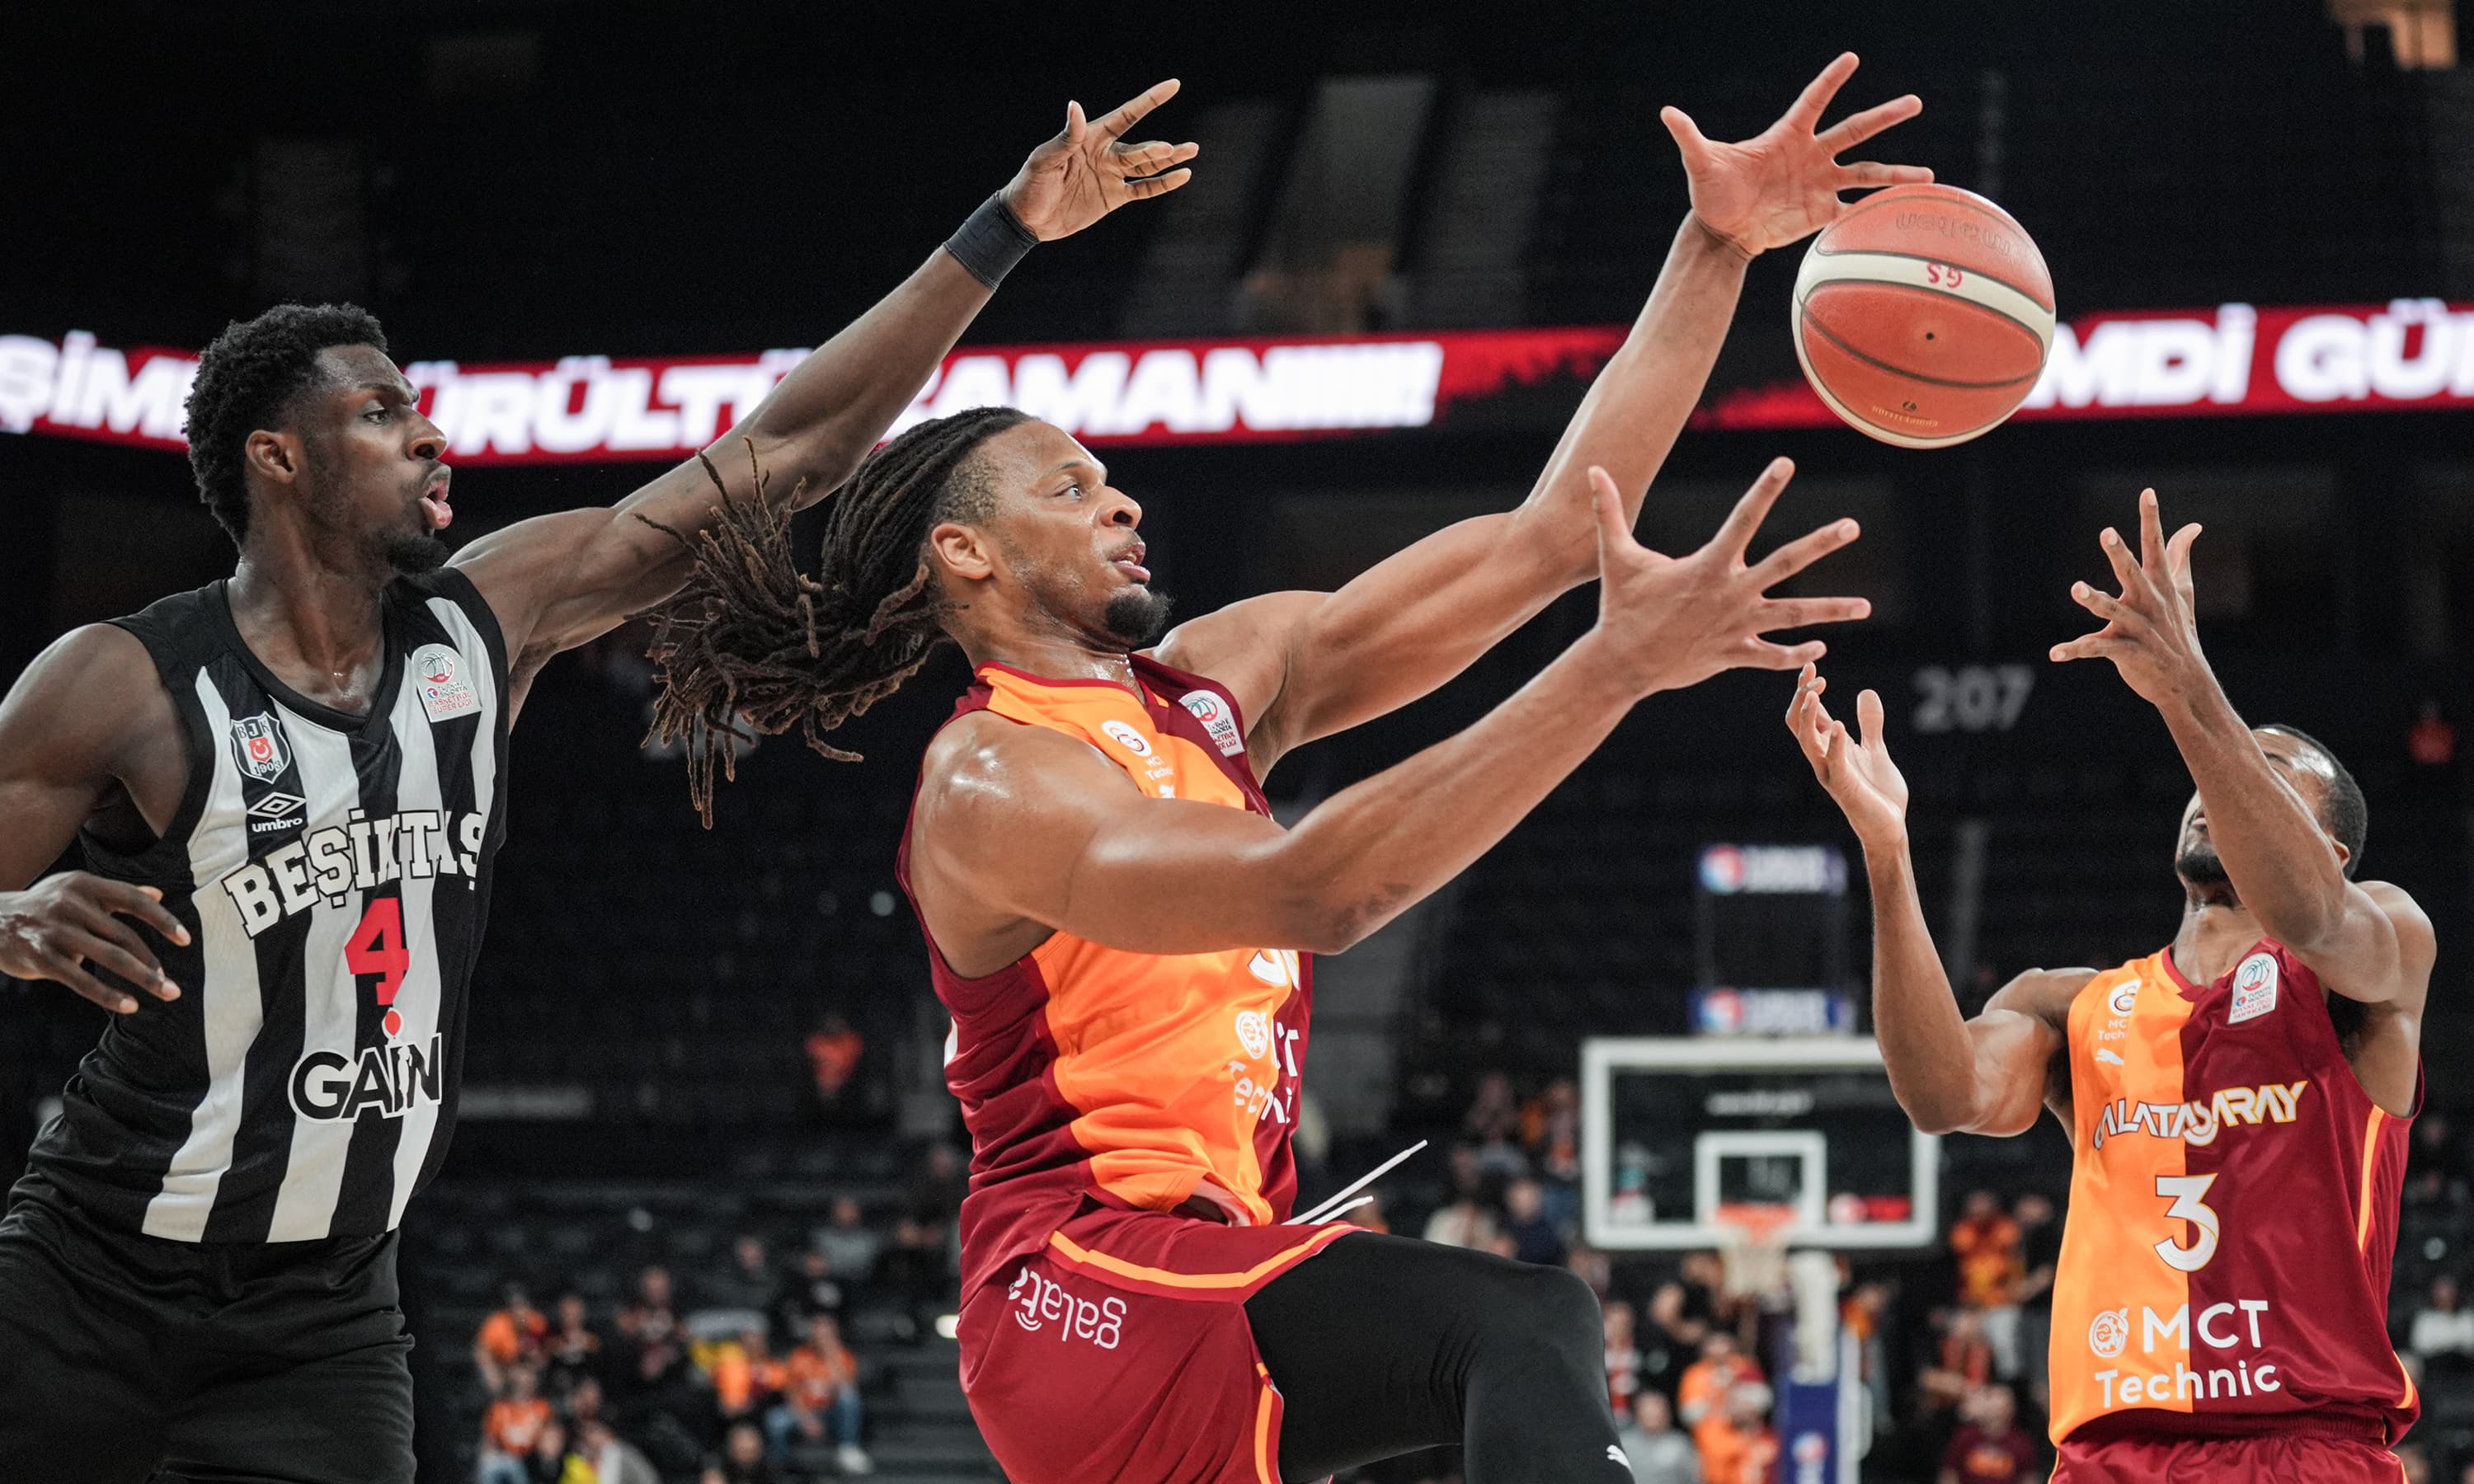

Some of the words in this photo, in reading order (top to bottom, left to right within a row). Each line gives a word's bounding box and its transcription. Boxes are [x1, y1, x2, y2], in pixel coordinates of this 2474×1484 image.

[1926, 261, 1964, 289] GS
[2020, 303, 2257, 409] MDİ
[0, 329, 203, 443] ŞİM
[403, 348, 814, 456] ÜRÜLT
[1912, 664, 2035, 732] 207
[237, 720, 270, 739] BJK
[253, 760, 284, 776] 1903
[252, 817, 303, 833] umbro
[344, 896, 410, 1007] 4
[2097, 1028, 2126, 1040] Tech
[2108, 1019, 2128, 1029] MC
[2153, 1172, 2220, 1272] 3
[2142, 1298, 2269, 1353] MCT
[2095, 1360, 2281, 1408] Technic
